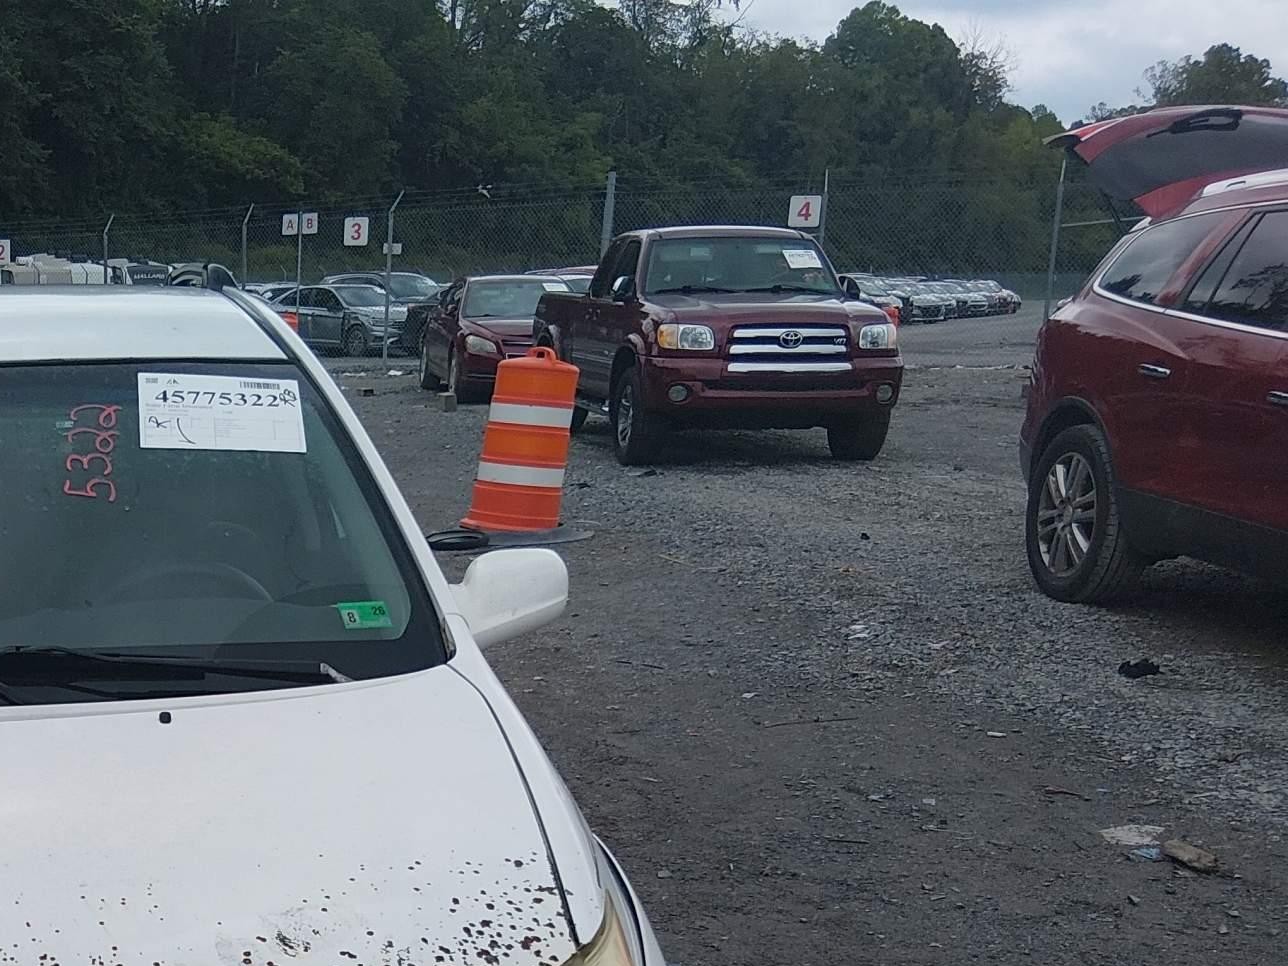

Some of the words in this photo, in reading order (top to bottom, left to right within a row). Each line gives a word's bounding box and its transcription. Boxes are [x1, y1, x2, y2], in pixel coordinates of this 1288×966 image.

[796, 201, 812, 221] 4
[286, 219, 294, 231] A
[306, 218, 313, 230] B
[350, 222, 362, 240] 3
[155, 389, 280, 408] 45775322
[63, 404, 123, 502] 5322
[347, 612, 357, 623] 8
[371, 606, 386, 616] 26
